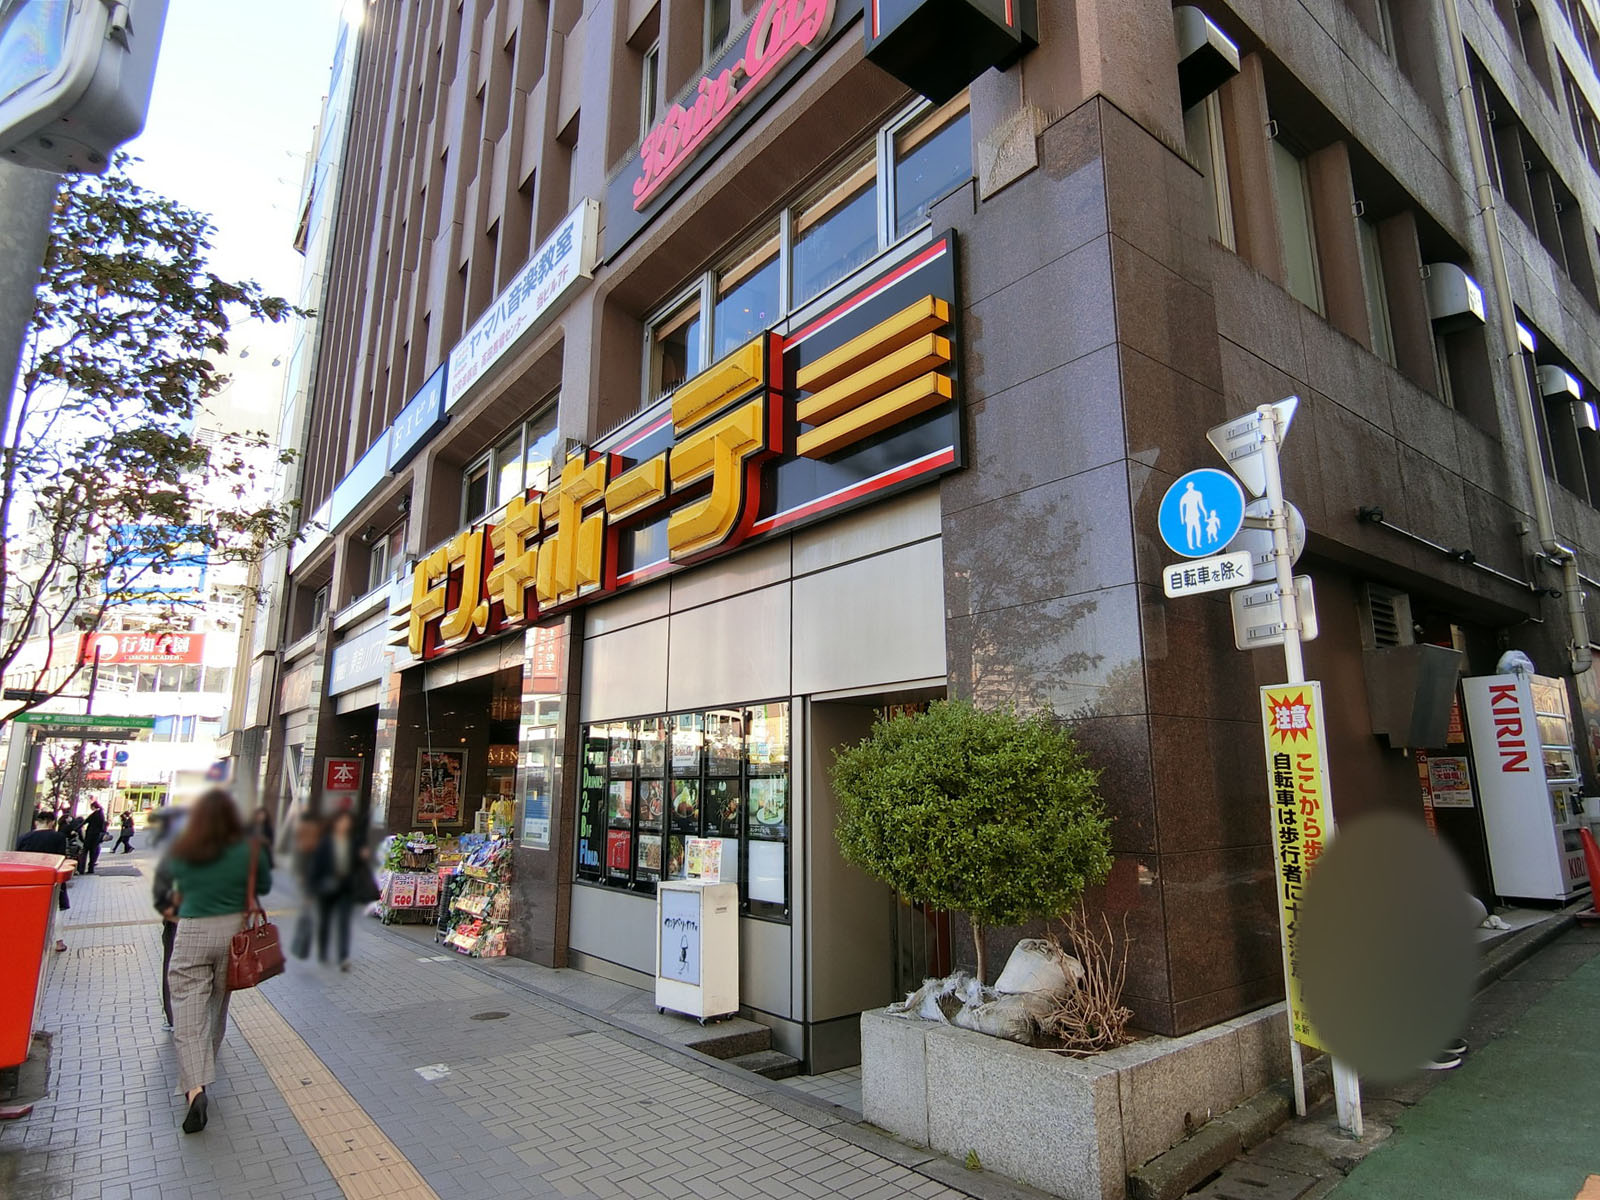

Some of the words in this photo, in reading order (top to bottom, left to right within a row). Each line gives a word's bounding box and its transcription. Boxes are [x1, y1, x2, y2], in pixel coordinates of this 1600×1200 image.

[469, 221, 574, 358] ヤマハ音楽教室
[1170, 561, 1245, 590] 自転車を除く
[121, 636, 190, 654] 行知学園
[1275, 704, 1308, 730] 注意
[1488, 683, 1530, 773] KIRIN
[334, 763, 353, 783] 本
[1567, 855, 1586, 881] KIRI
[394, 894, 412, 905] 500
[420, 894, 436, 905] 500
